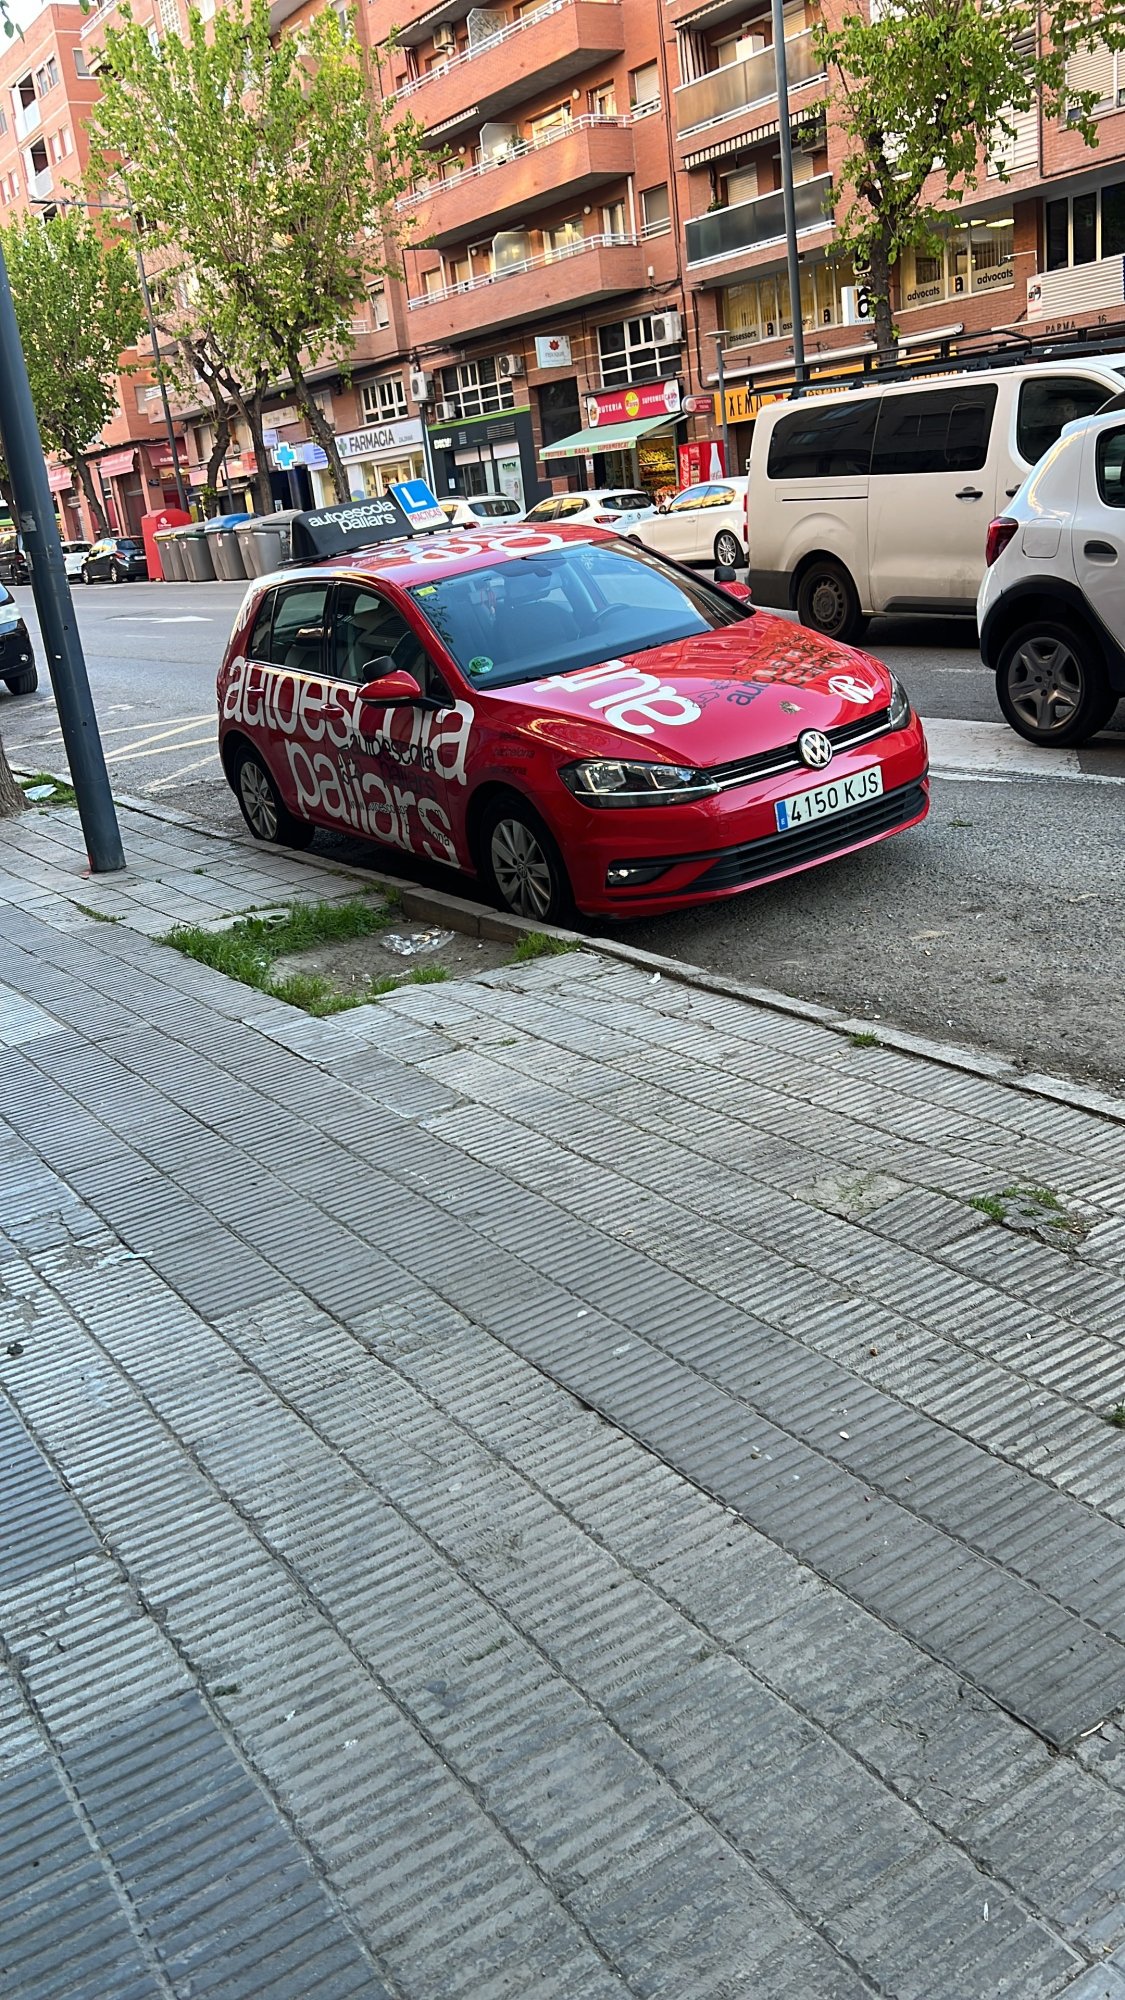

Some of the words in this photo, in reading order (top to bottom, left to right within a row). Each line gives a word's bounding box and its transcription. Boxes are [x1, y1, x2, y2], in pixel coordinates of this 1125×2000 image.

[977, 268, 1014, 286] advocats
[907, 285, 940, 301] advocats
[729, 330, 757, 343] assessors
[1045, 321, 1076, 334] PARMA
[725, 392, 763, 417] XEMA
[349, 428, 395, 453] FARMACIA
[401, 487, 428, 508] L
[308, 500, 396, 527] autoescola
[339, 513, 397, 534] pallars
[223, 655, 474, 785] autoescola
[284, 738, 461, 869] pallars
[791, 787, 839, 822] 4150
[844, 772, 879, 803] KJS
